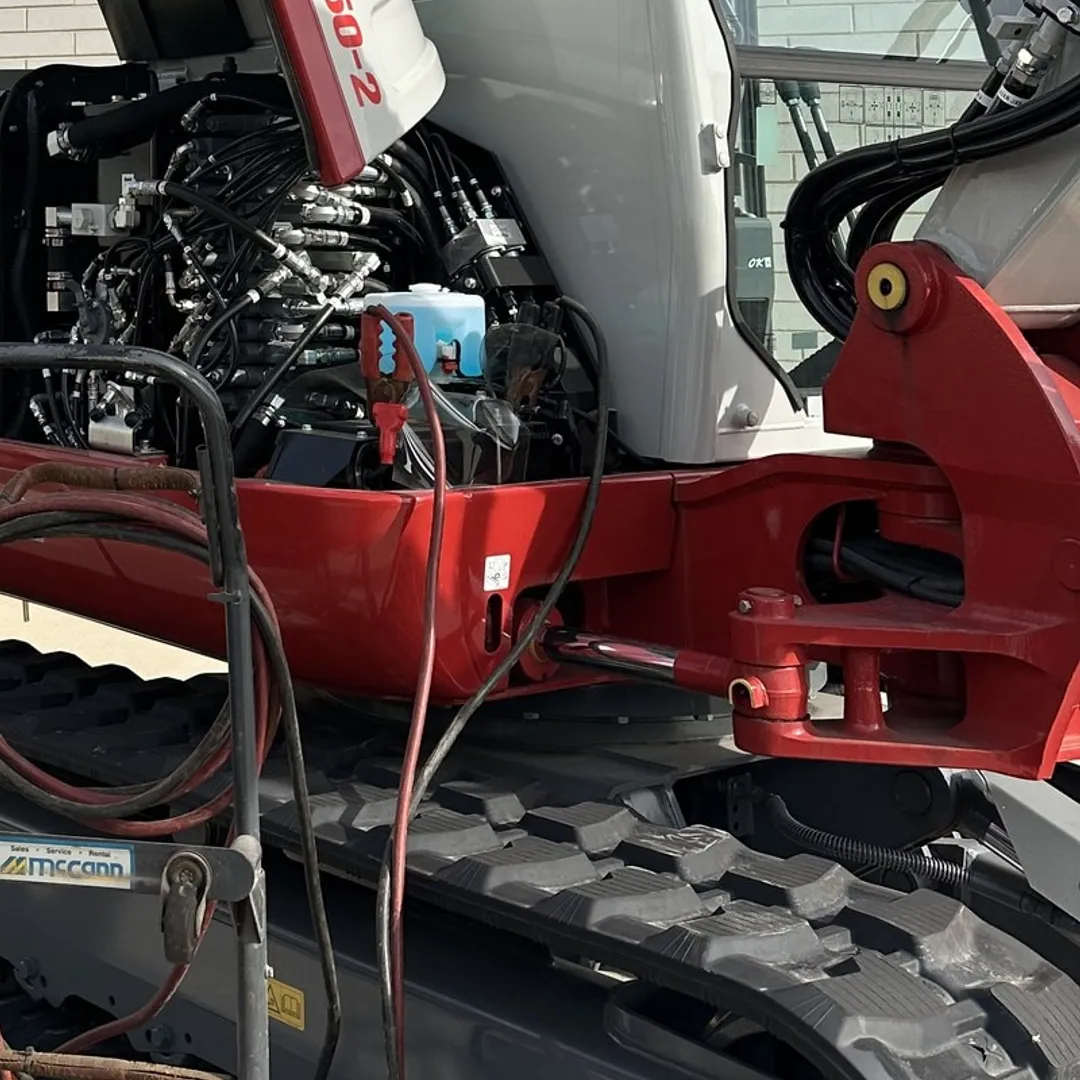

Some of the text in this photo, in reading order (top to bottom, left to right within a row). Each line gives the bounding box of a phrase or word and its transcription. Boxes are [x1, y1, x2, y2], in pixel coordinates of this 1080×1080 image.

[10, 845, 111, 858] Sales Service Rental
